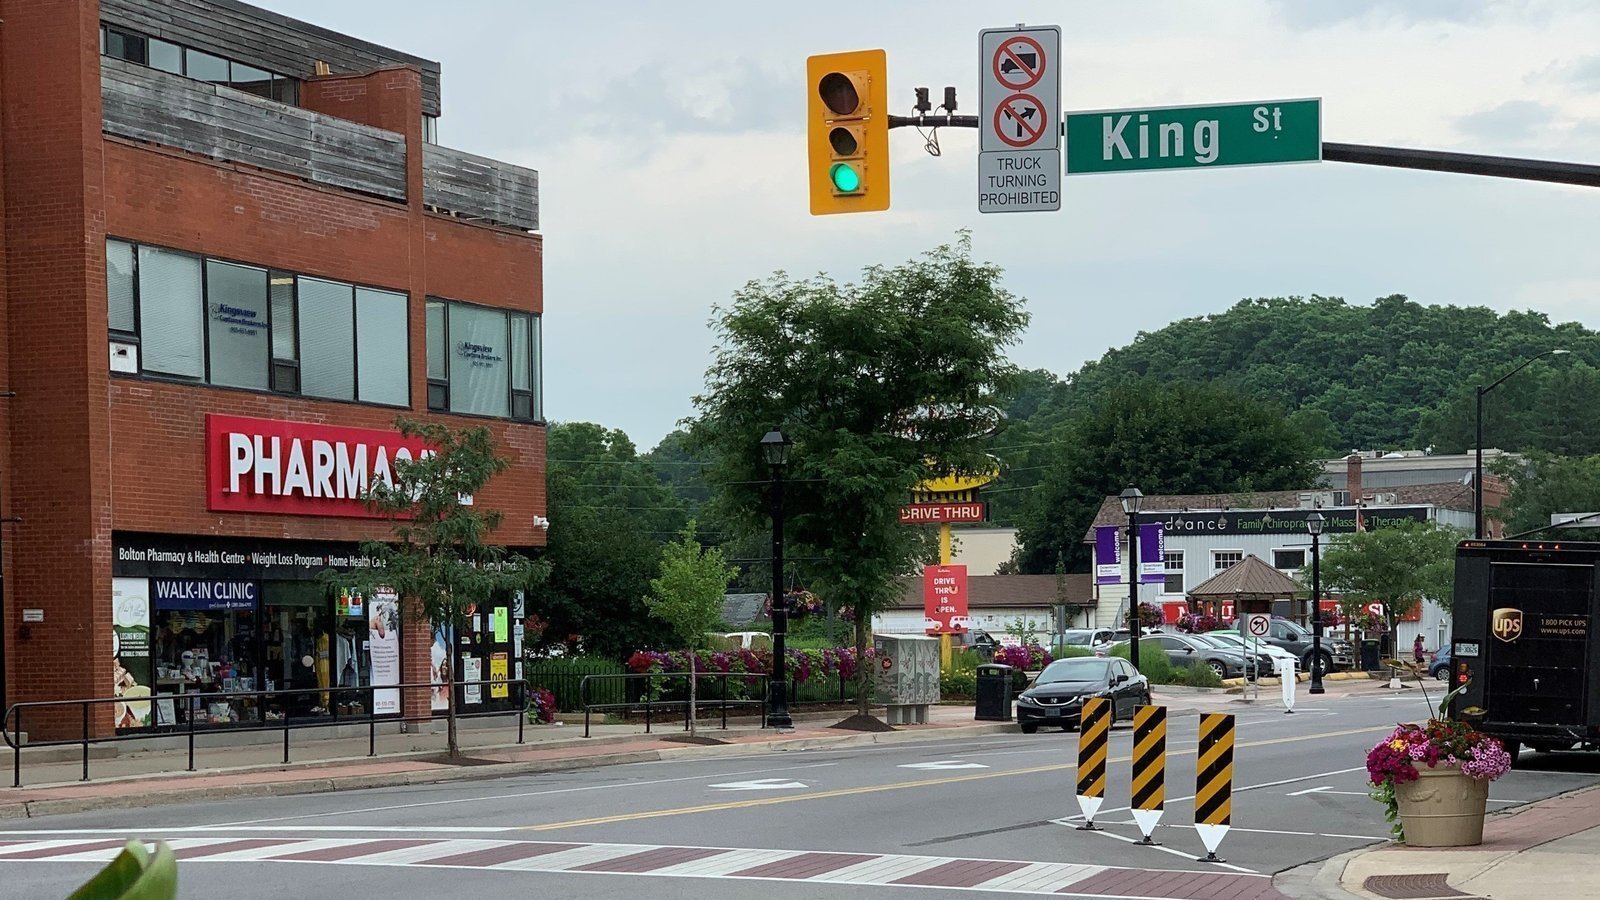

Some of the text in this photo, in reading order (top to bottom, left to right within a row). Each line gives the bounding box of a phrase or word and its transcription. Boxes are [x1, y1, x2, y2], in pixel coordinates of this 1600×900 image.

[1102, 106, 1282, 164] King St
[996, 157, 1041, 170] TRUCK
[988, 173, 1047, 188] TURNING
[980, 190, 1059, 206] PROHIBITED
[943, 506, 980, 519] THRU
[1237, 517, 1264, 532] Family
[119, 546, 146, 561] Bolton
[147, 548, 186, 566] Pharmacy
[187, 551, 193, 563] &
[194, 550, 219, 563] Health
[220, 551, 245, 564] Centre
[251, 552, 277, 568] Weight
[278, 553, 293, 565] Loss
[294, 553, 323, 569] Program
[328, 554, 348, 567] Home
[349, 554, 371, 567] Health
[933, 577, 956, 585] DRIVE
[156, 580, 254, 600] WALK-IN CLINIC
[934, 585, 959, 595] THRU
[940, 596, 949, 604] IS
[1494, 618, 1521, 638] ups
[1545, 619, 1558, 627] 800
[1558, 619, 1573, 627] PICK
[1574, 619, 1587, 627] UPS
[1540, 627, 1586, 636] www.ups.com
